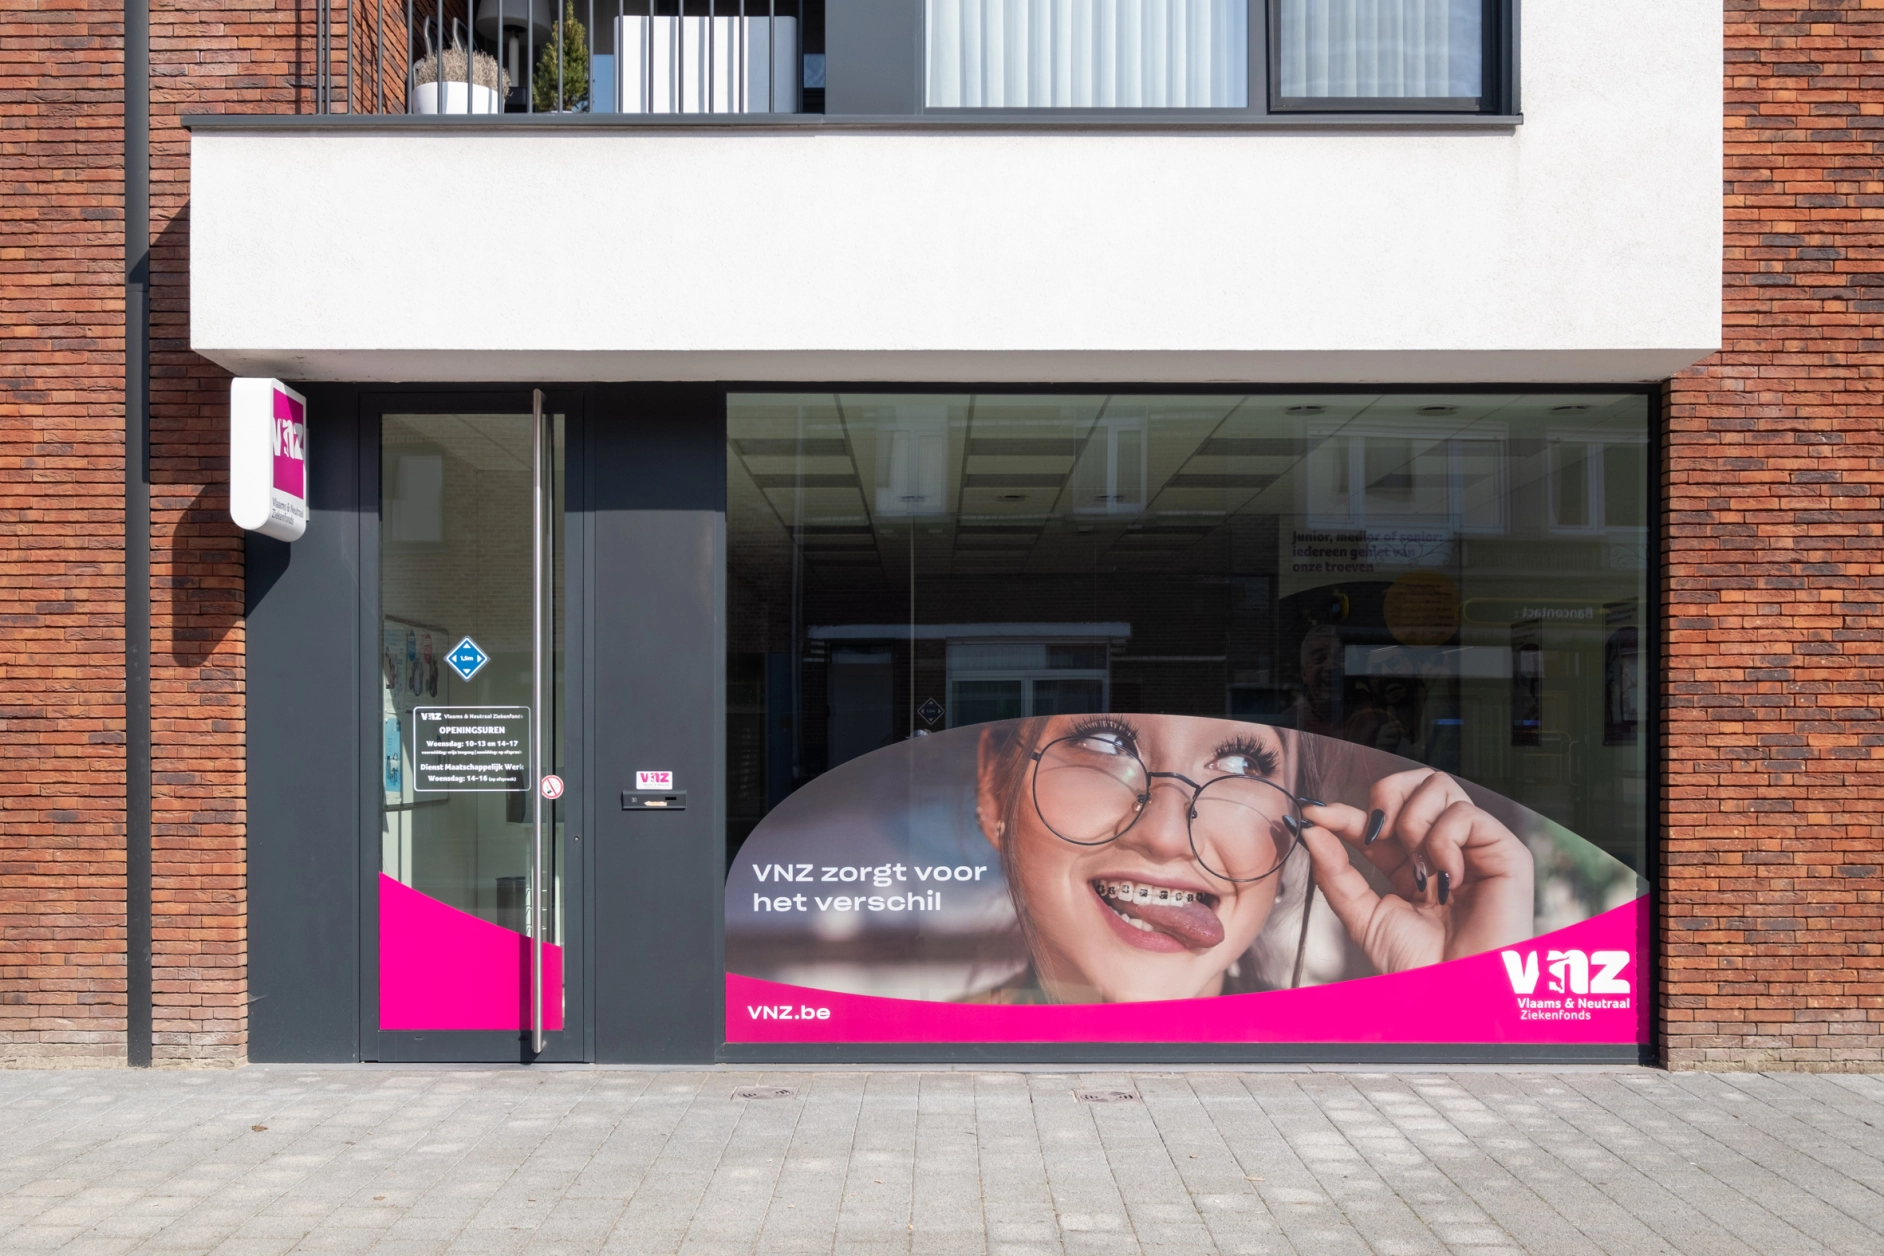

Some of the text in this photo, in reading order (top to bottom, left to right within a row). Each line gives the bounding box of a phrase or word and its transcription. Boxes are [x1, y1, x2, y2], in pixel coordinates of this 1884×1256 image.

[271, 508, 294, 525] Ziekenfonds
[1292, 531, 1333, 545] Junior,
[1383, 530, 1398, 542] of
[1292, 546, 1347, 557] iedereen
[1292, 562, 1374, 573] onze troeven
[439, 726, 506, 734] OPENINGSUREN
[426, 740, 464, 749] Woensdag:
[420, 763, 524, 772] Dienst Maatschappelijk Werk
[427, 775, 466, 783] Woensdag:
[752, 862, 988, 887] VNZ zorgt voor
[753, 890, 941, 912] het verschil
[1517, 998, 1630, 1009] Vlaams & Neutraal
[747, 1005, 831, 1020] VNZ.be
[1520, 1009, 1591, 1020] Ziekenfonds
